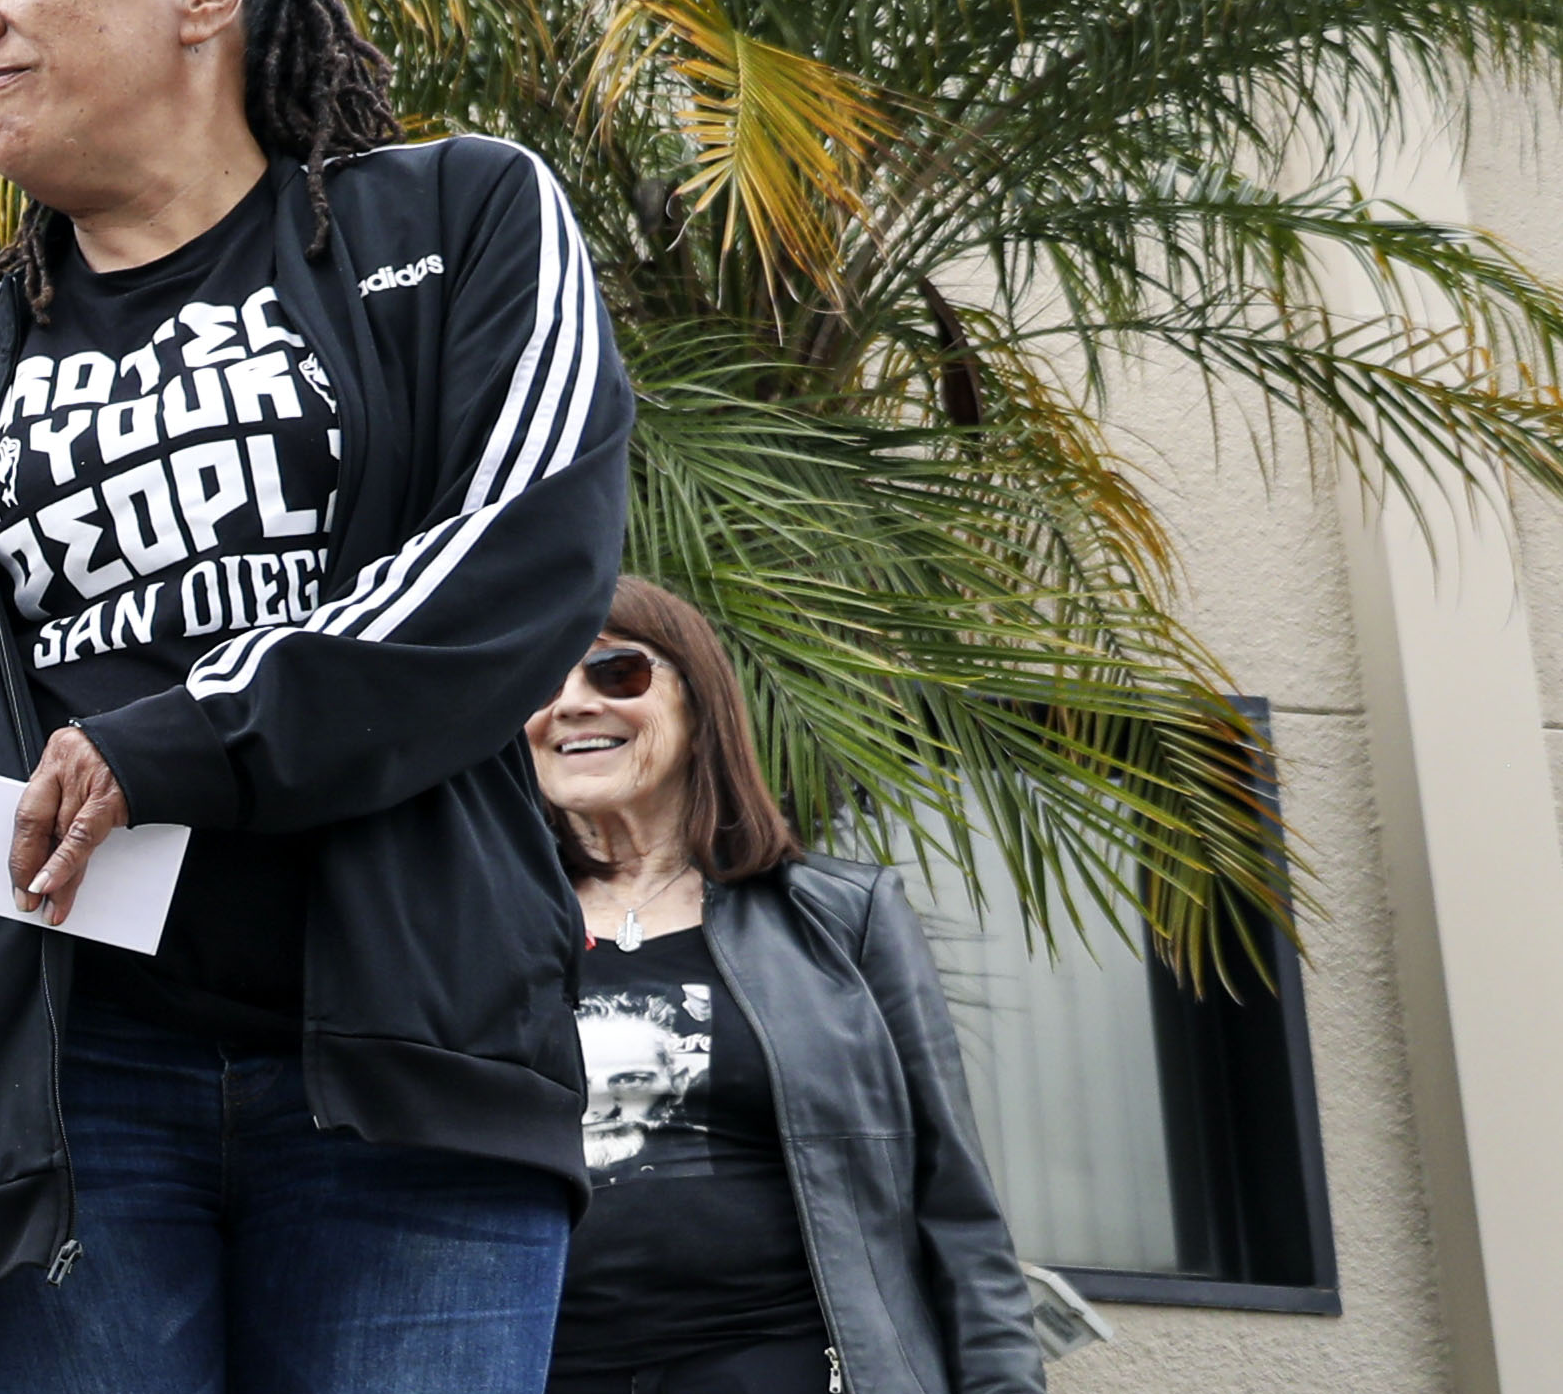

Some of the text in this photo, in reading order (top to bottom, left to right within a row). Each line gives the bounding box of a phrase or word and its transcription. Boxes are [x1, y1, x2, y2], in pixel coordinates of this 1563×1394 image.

[30, 350, 303, 485] YOUR
[33, 582, 165, 669] SAN
[181, 549, 327, 637] DIEG
